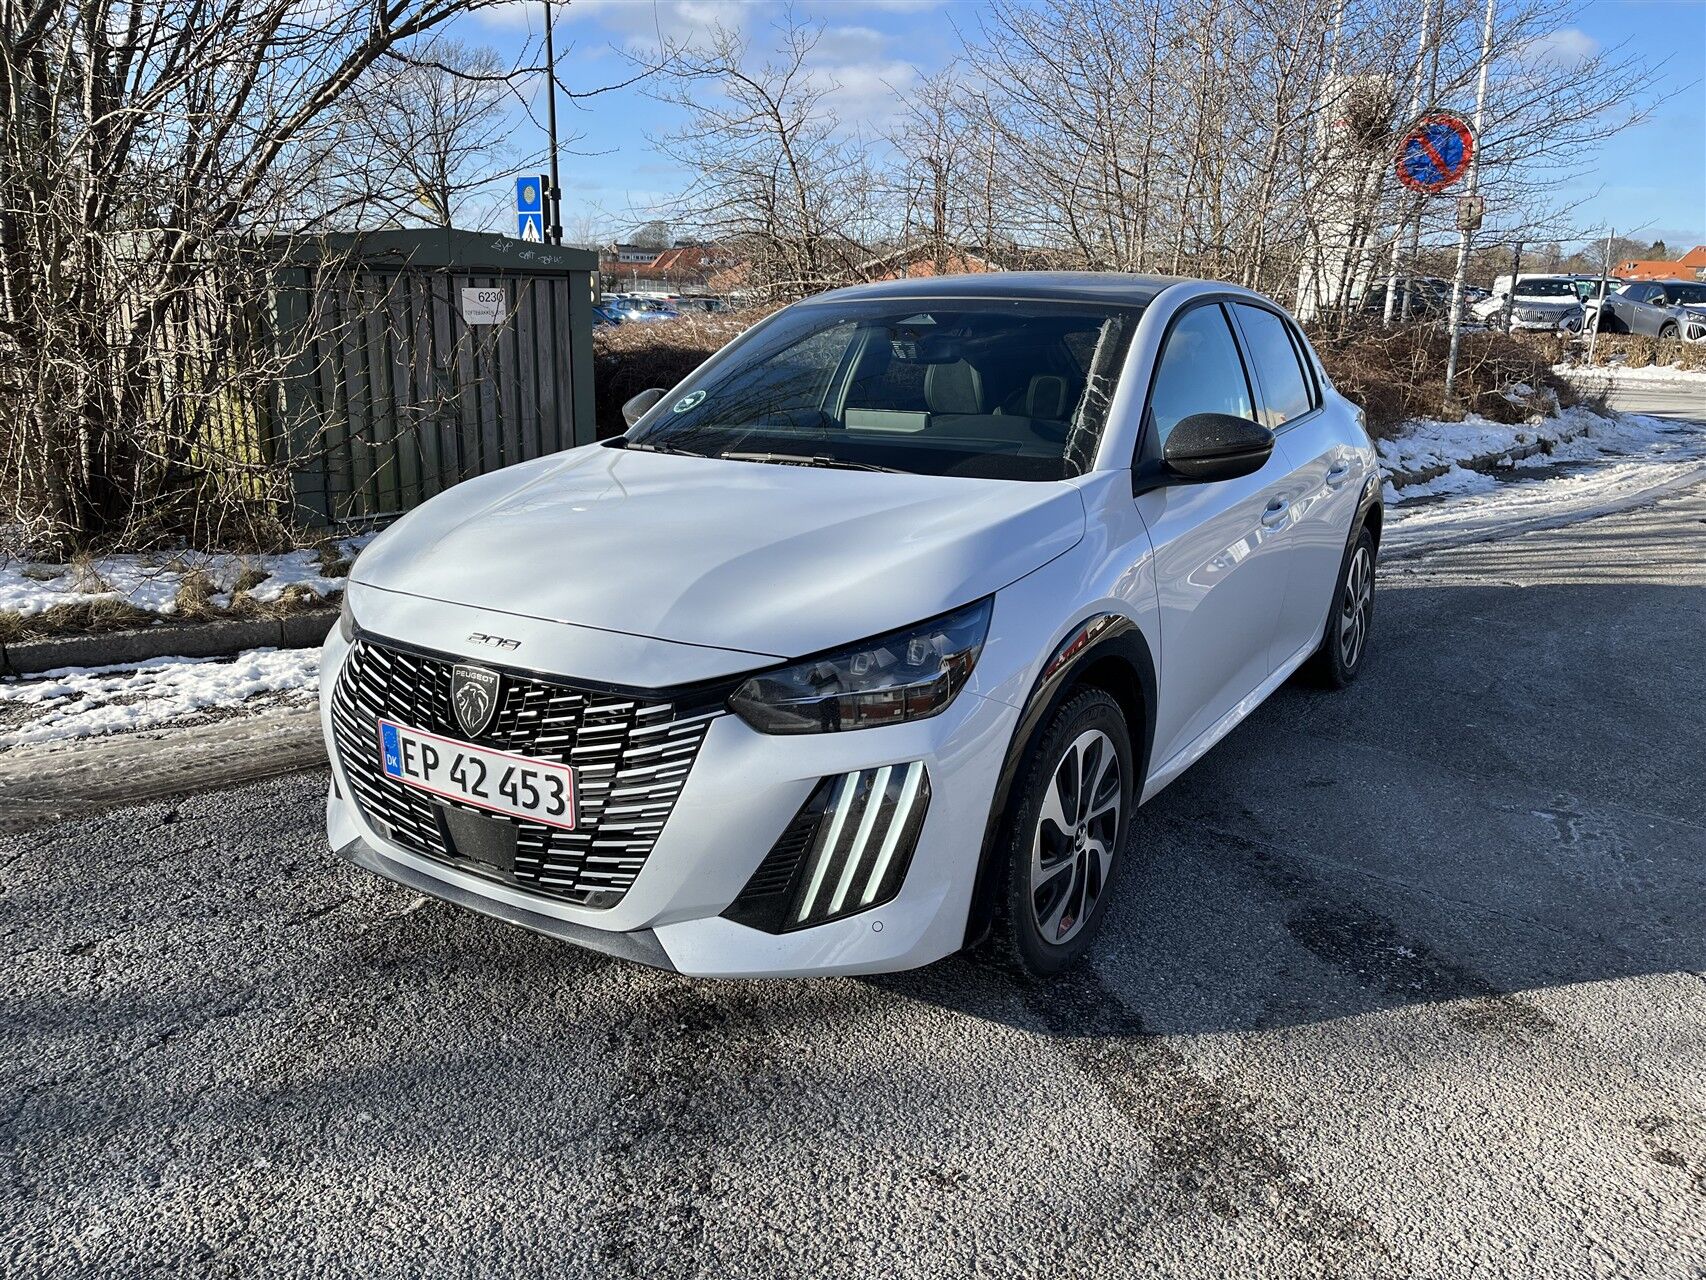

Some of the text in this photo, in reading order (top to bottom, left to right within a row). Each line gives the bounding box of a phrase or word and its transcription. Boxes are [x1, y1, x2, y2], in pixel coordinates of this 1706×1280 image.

[478, 291, 504, 303] 6230
[466, 632, 522, 652] 208
[455, 670, 495, 684] PEUGEOT
[386, 753, 398, 768] DK
[401, 736, 566, 816] EP 42 453
